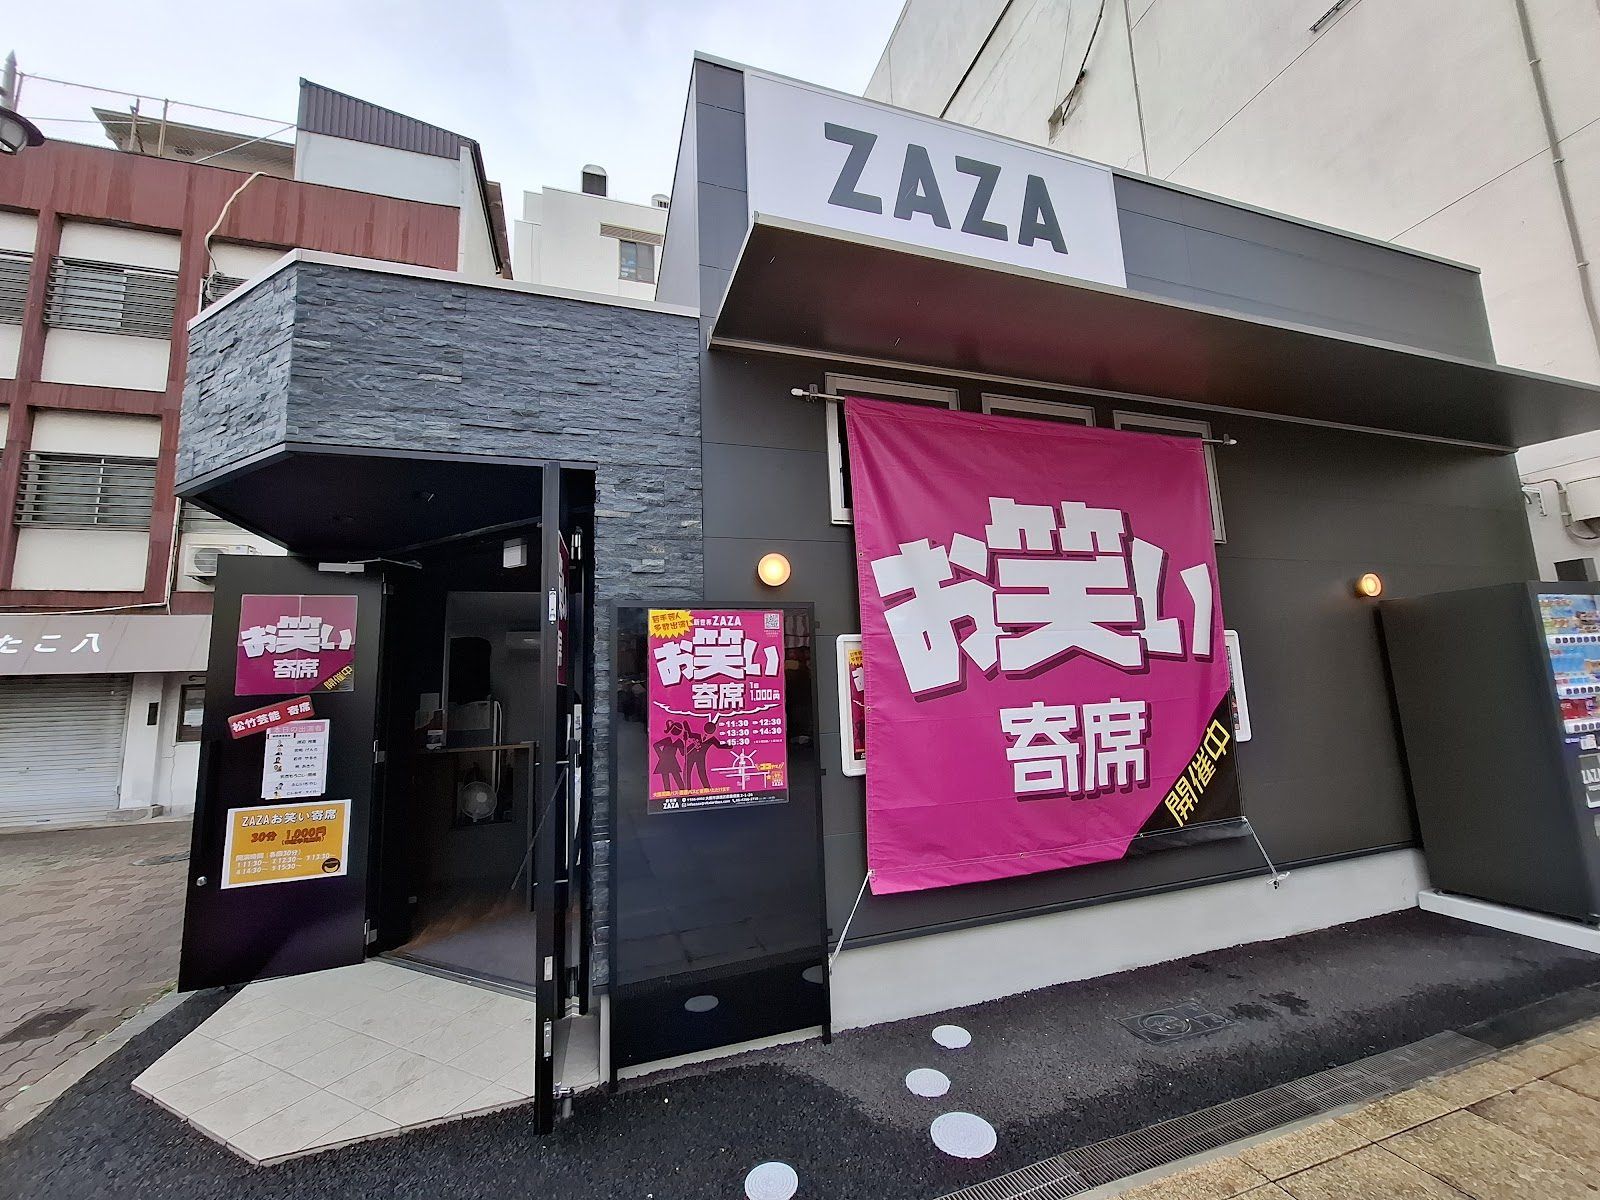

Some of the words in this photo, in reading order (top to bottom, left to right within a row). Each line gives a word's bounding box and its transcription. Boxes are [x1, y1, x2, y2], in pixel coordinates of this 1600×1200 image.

[824, 121, 1069, 255] ZAZA
[870, 497, 1213, 697] お笑い
[241, 616, 352, 658] お笑い
[273, 658, 320, 679] 寄席
[654, 628, 780, 686] お笑い
[692, 681, 745, 709] 寄席
[232, 710, 282, 733] 松竹芸能
[286, 702, 311, 716] 寄席
[726, 720, 749, 728] 11:30
[759, 718, 782, 726] 12:30
[727, 729, 750, 737] 13:30
[760, 727, 782, 735] 14:30
[727, 738, 750, 746] 15:30
[999, 698, 1149, 798] 寄席
[1164, 718, 1231, 828] 開催中
[241, 809, 338, 827] ZAZAお笑い寄席
